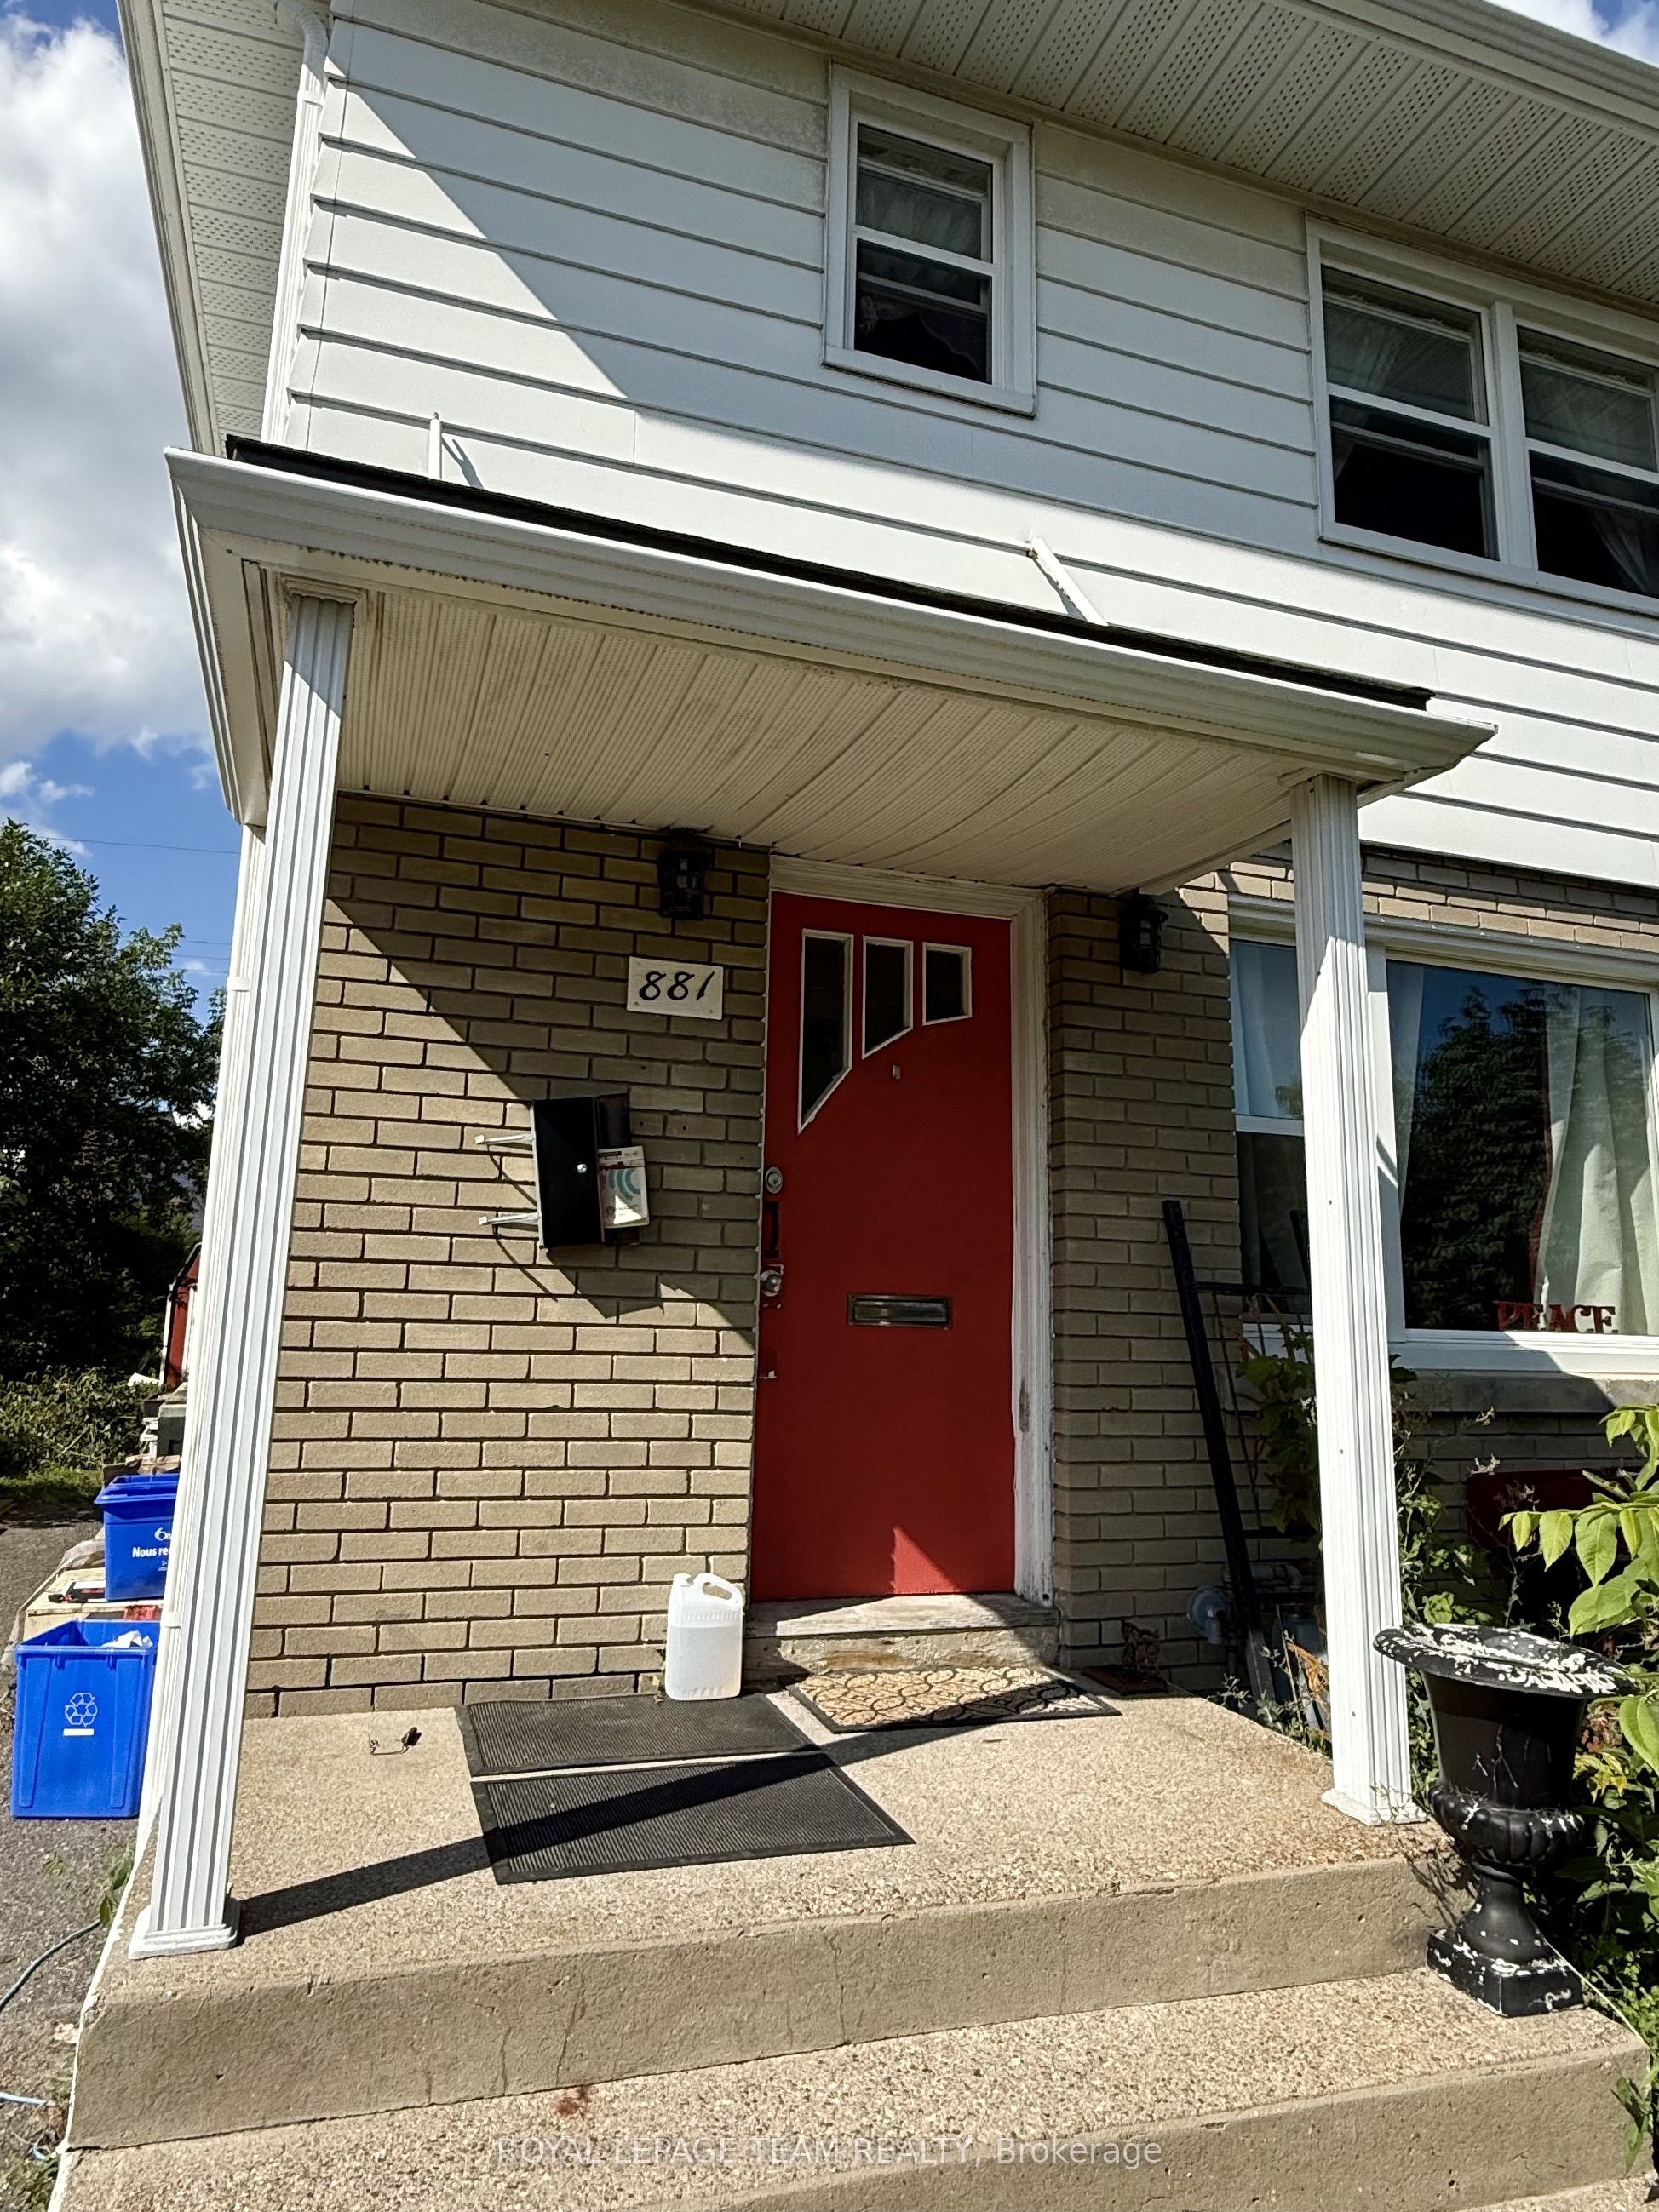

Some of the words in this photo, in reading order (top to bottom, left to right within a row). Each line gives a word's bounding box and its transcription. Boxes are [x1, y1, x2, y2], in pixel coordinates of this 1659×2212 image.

[639, 971, 715, 1000] 881
[1493, 1300, 1618, 1334] PEACE
[132, 1546, 158, 1557] Nous
